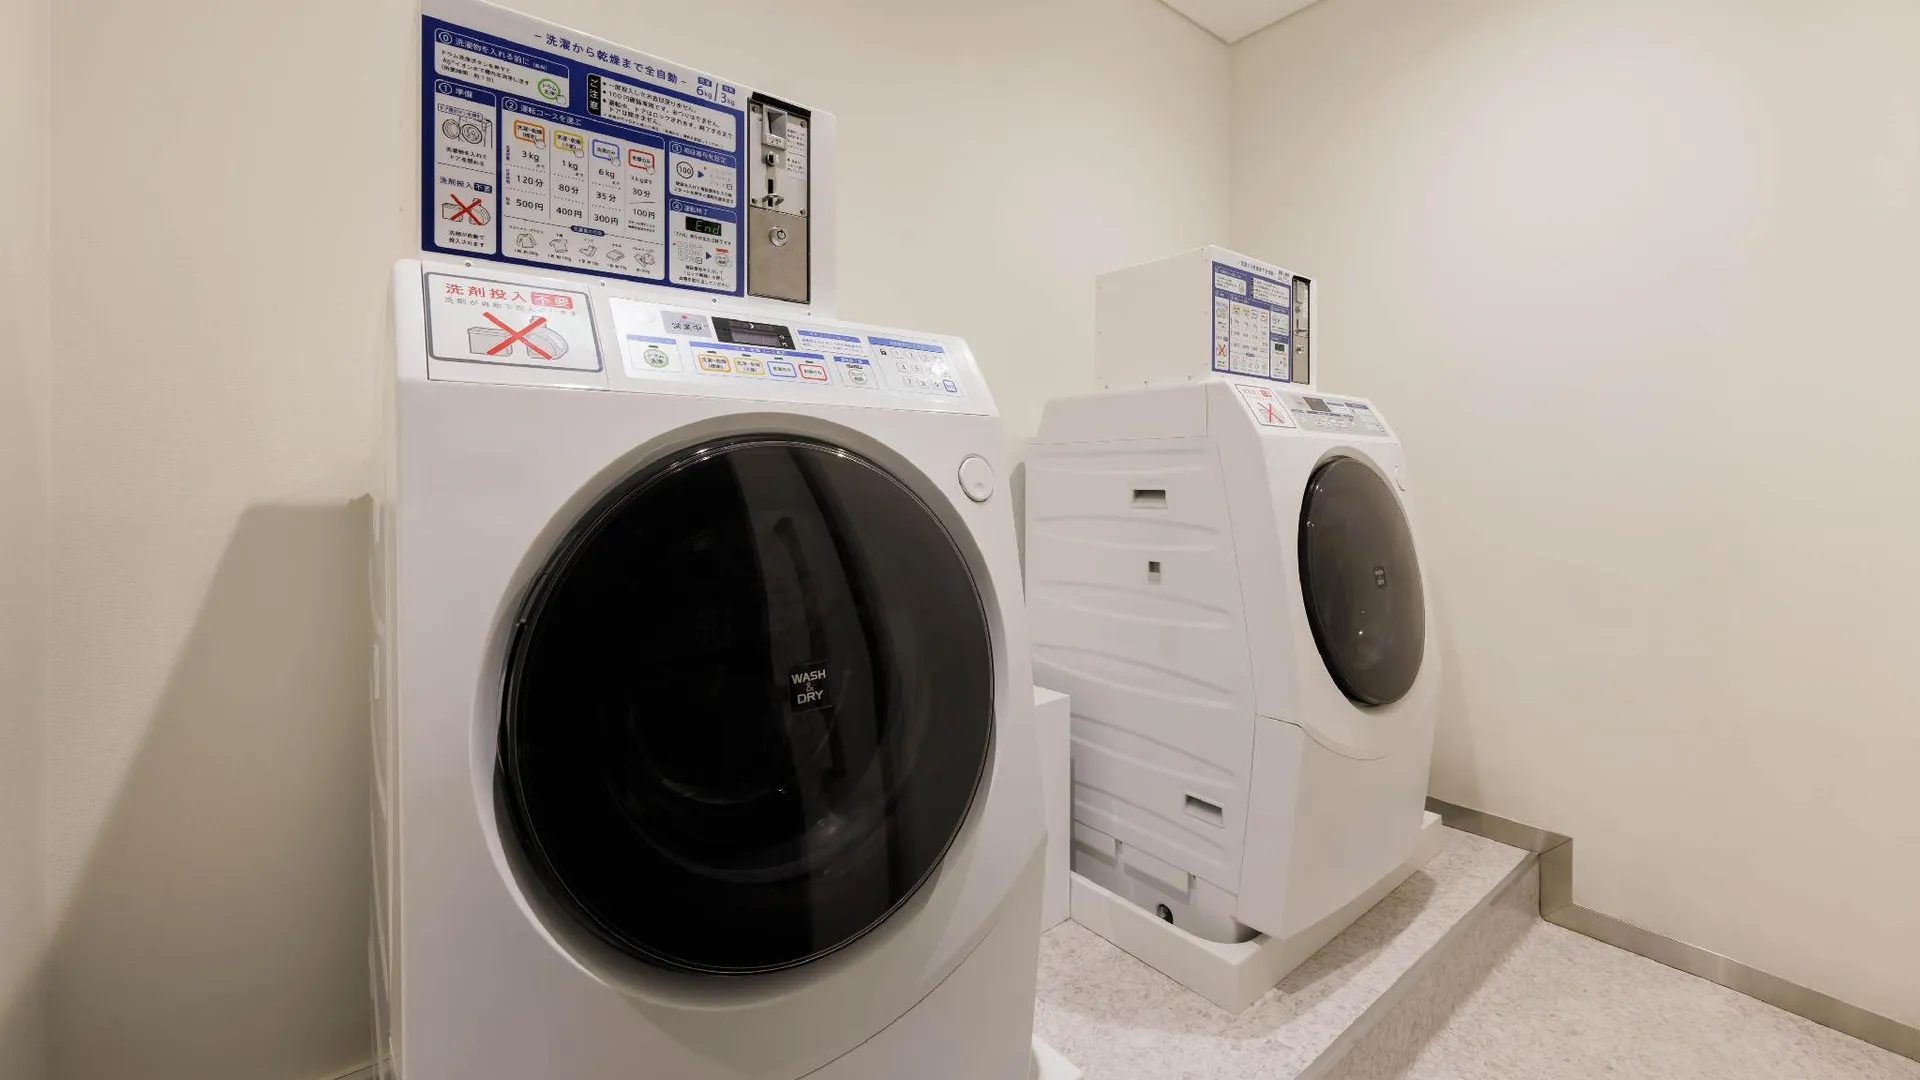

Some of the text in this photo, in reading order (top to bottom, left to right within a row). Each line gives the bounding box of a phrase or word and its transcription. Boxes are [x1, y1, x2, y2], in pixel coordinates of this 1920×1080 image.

[545, 32, 678, 84] 洗濯から乾燥まで全自動
[517, 174, 544, 188] 120分
[558, 184, 579, 194] 80分
[516, 198, 544, 212] 500円
[556, 207, 582, 218] 400円
[633, 208, 656, 220] 100円
[594, 214, 618, 226] 300円
[445, 282, 528, 303] 洗剤投入
[791, 669, 826, 684] WASH
[806, 682, 814, 692] &
[797, 690, 824, 704] DRY
